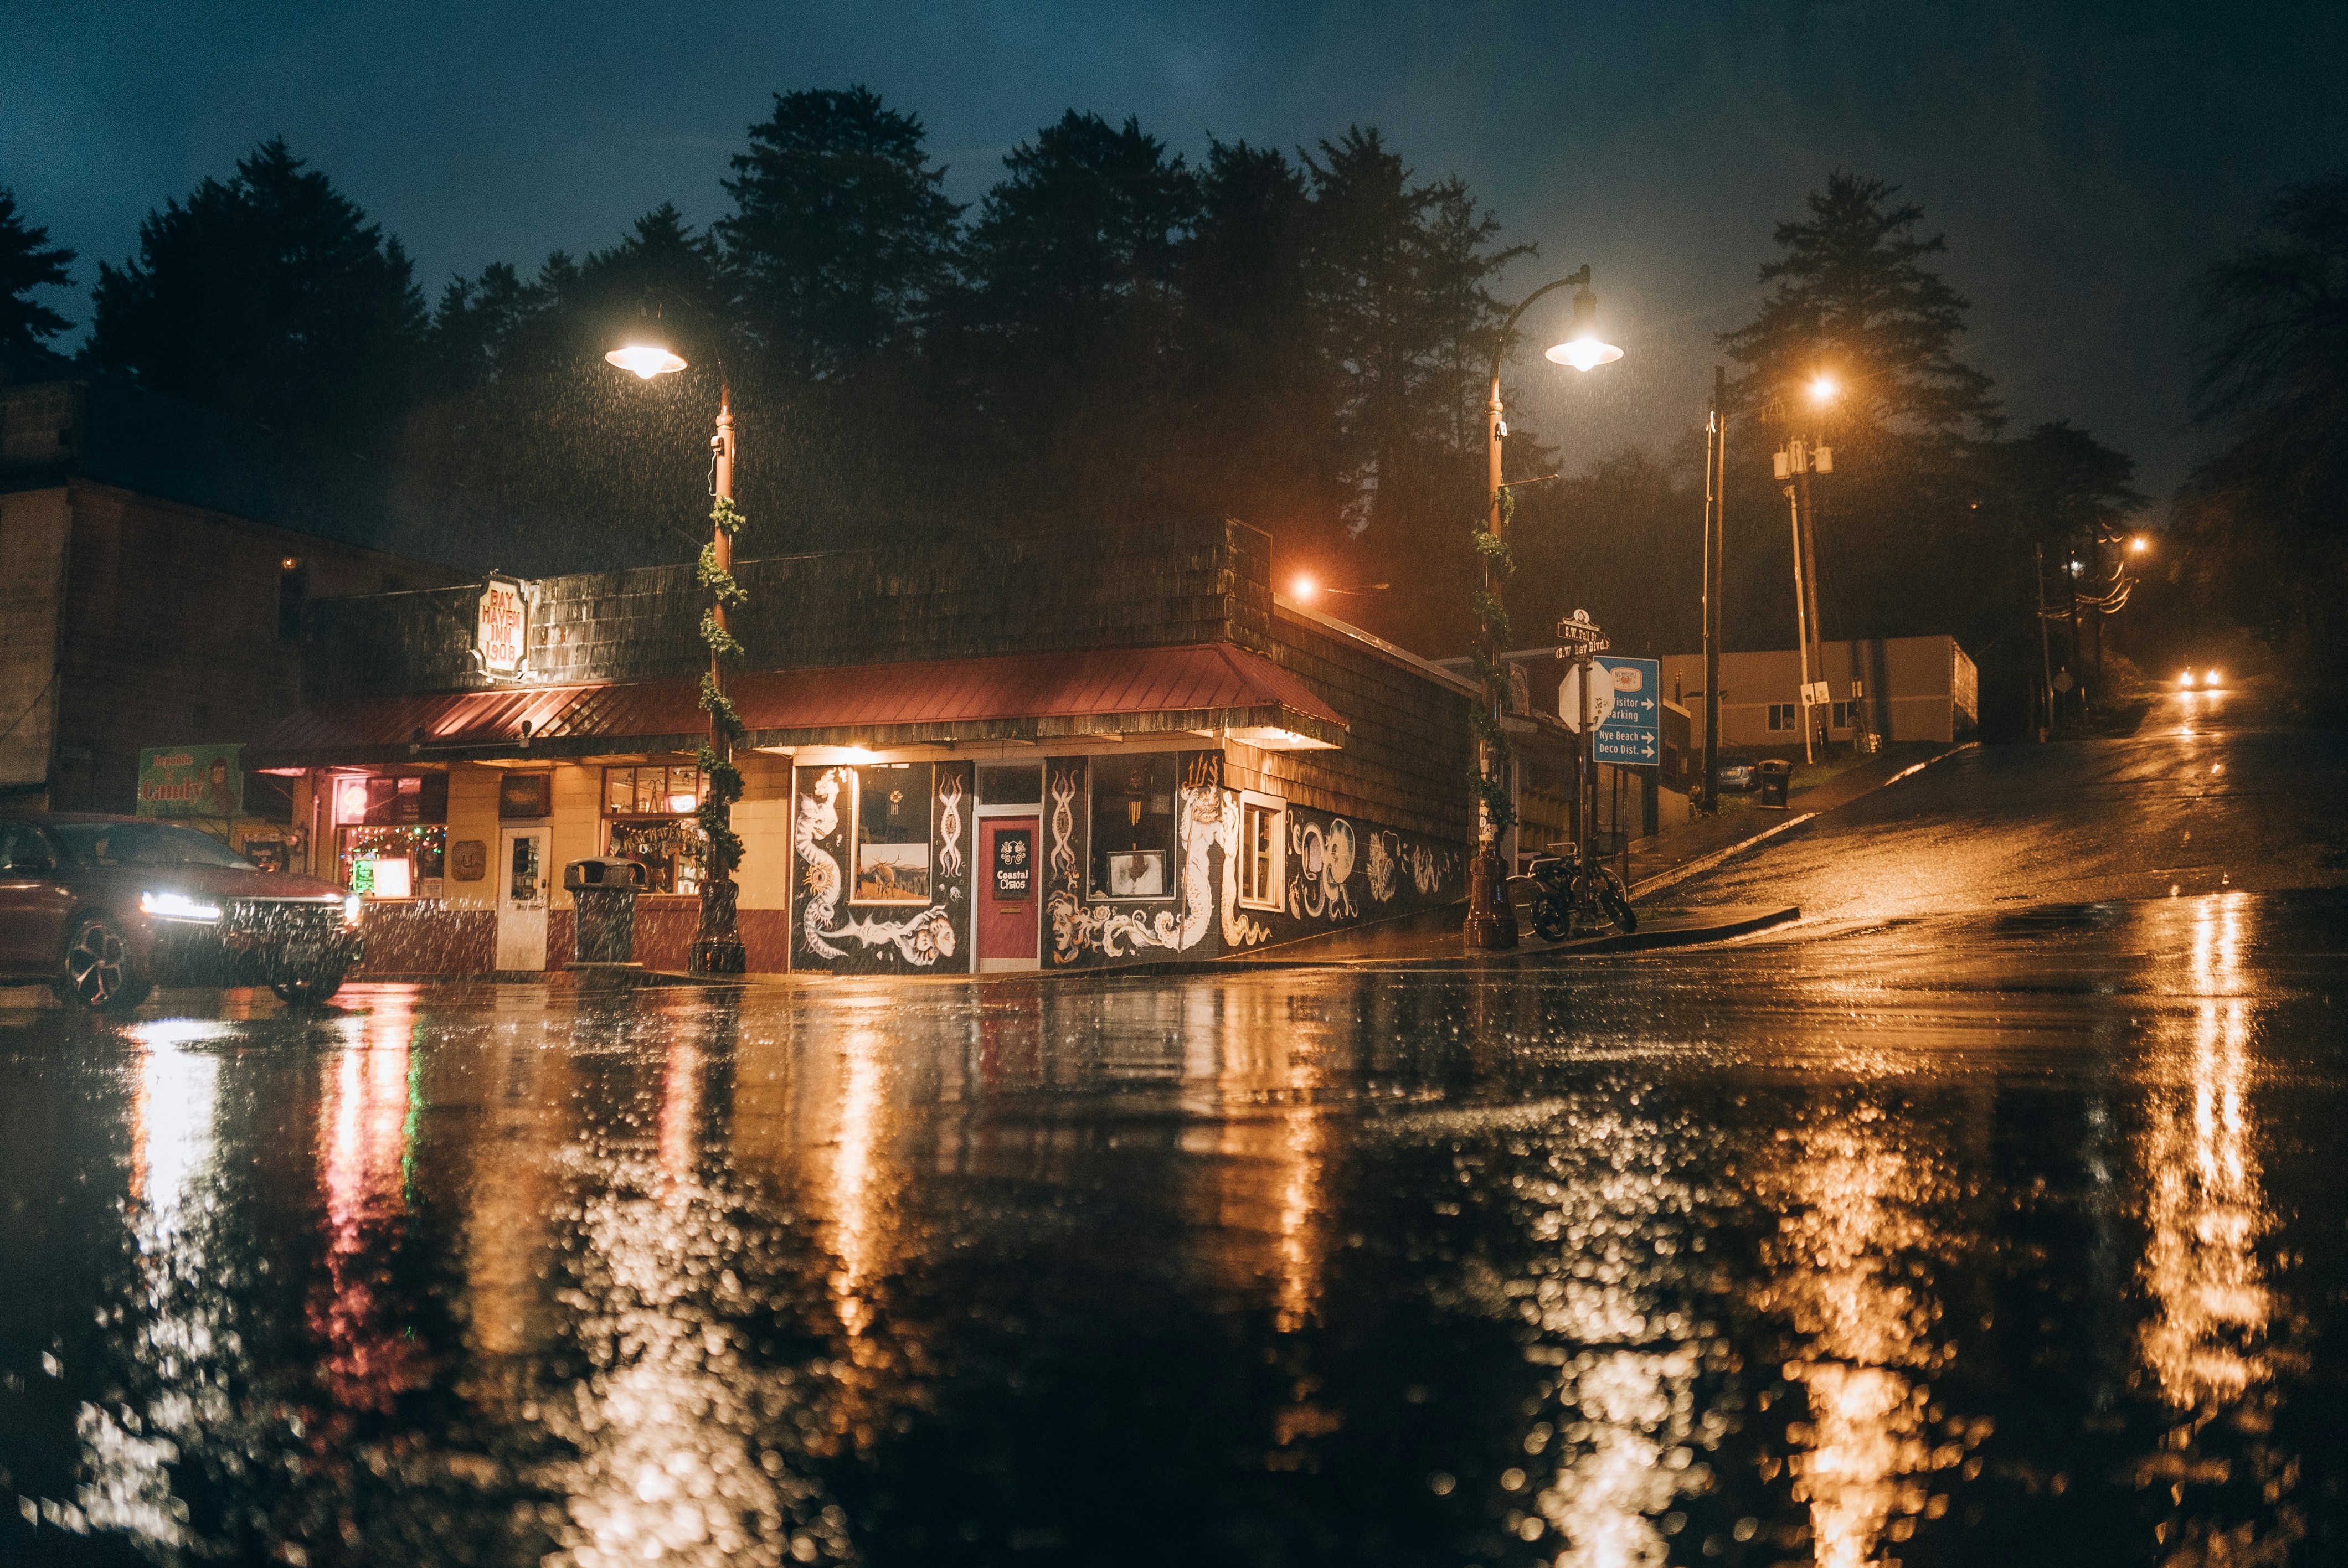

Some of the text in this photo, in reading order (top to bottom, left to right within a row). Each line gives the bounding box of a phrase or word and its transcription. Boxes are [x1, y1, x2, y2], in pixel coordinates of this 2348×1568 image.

[490, 589, 513, 609] BAY
[482, 605, 520, 628] HAVEN
[491, 625, 511, 644] INN
[1566, 626, 1578, 638] S.W.
[1579, 629, 1589, 641] Fall
[486, 641, 515, 661] 1908
[1575, 644, 1587, 655] Bay
[1589, 639, 1606, 652] Blvd.
[1608, 710, 1638, 722] arking
[1599, 730, 1639, 742] Nye Beach
[1599, 744, 1639, 755] Deco Dist.
[143, 777, 204, 806] Candy
[648, 827, 683, 843] HAVEN
[997, 870, 1028, 880] Coastal
[1000, 879, 1026, 889] Chaos
